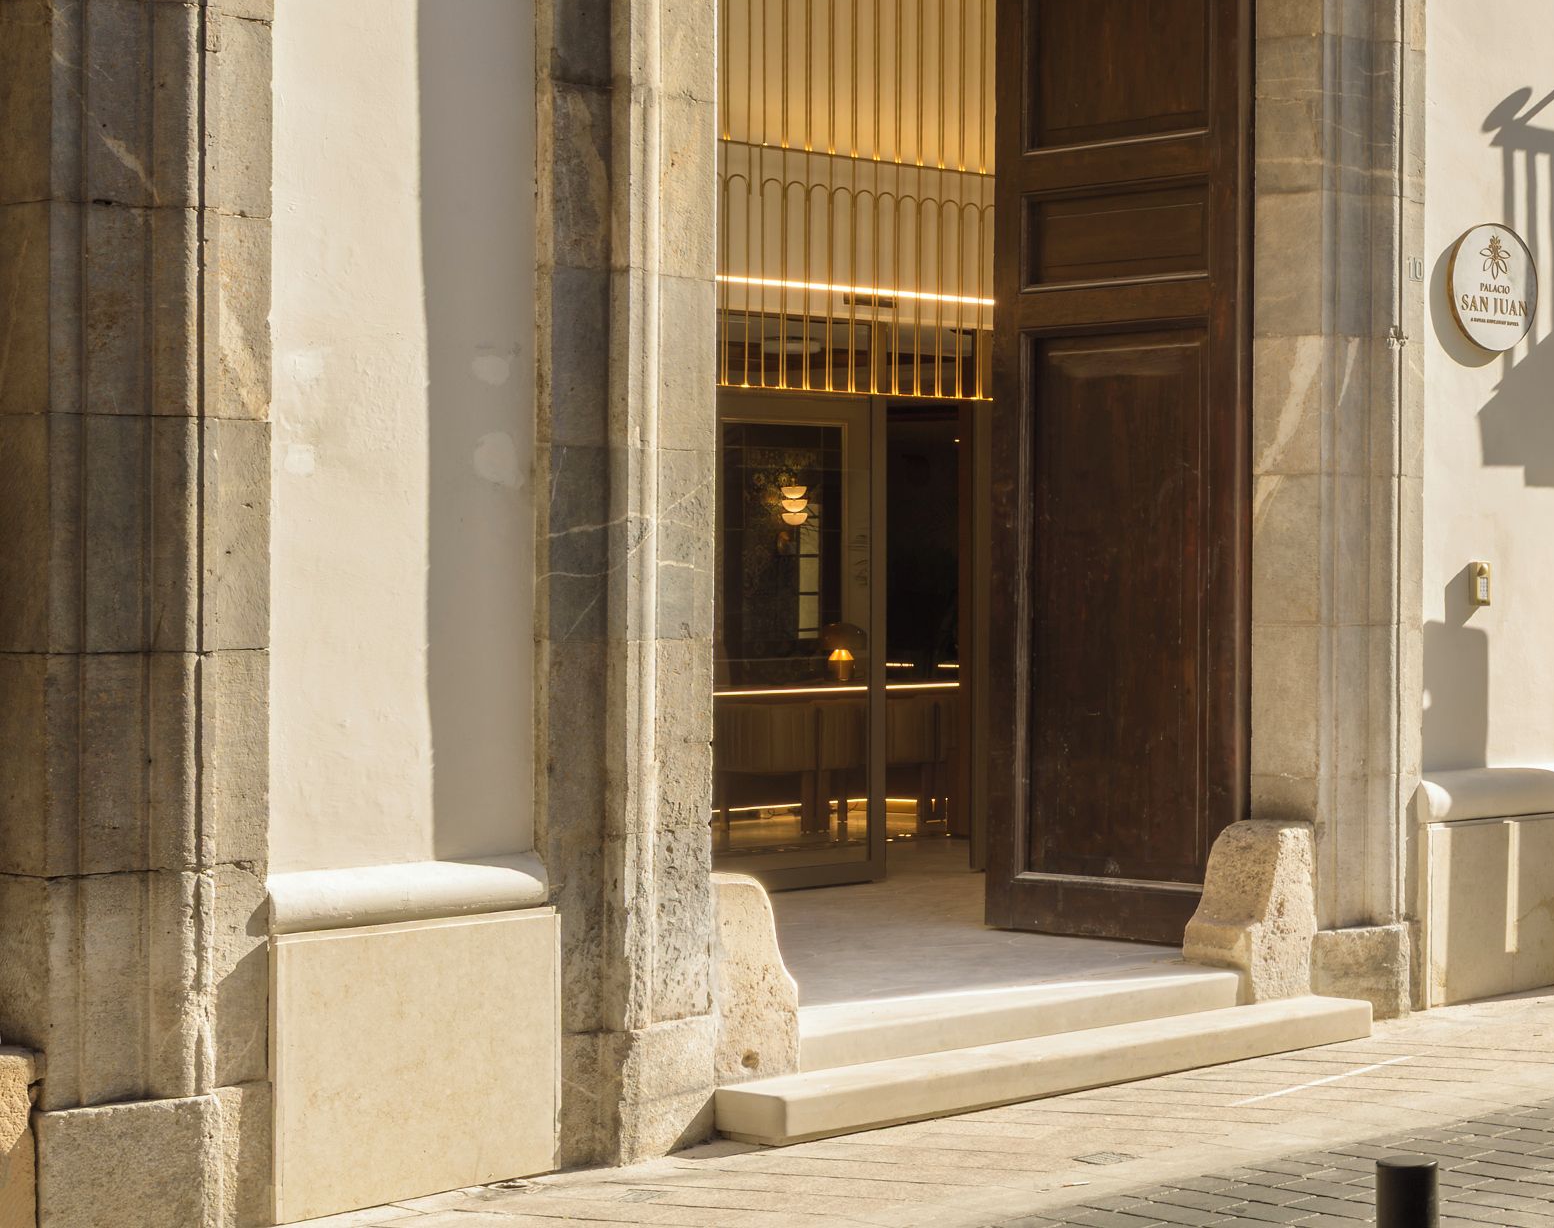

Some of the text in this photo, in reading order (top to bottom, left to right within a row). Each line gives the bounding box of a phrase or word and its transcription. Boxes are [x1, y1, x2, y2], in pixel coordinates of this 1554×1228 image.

[1479, 282, 1510, 295] PALACIO
[1461, 293, 1528, 317] SAN JUAN
